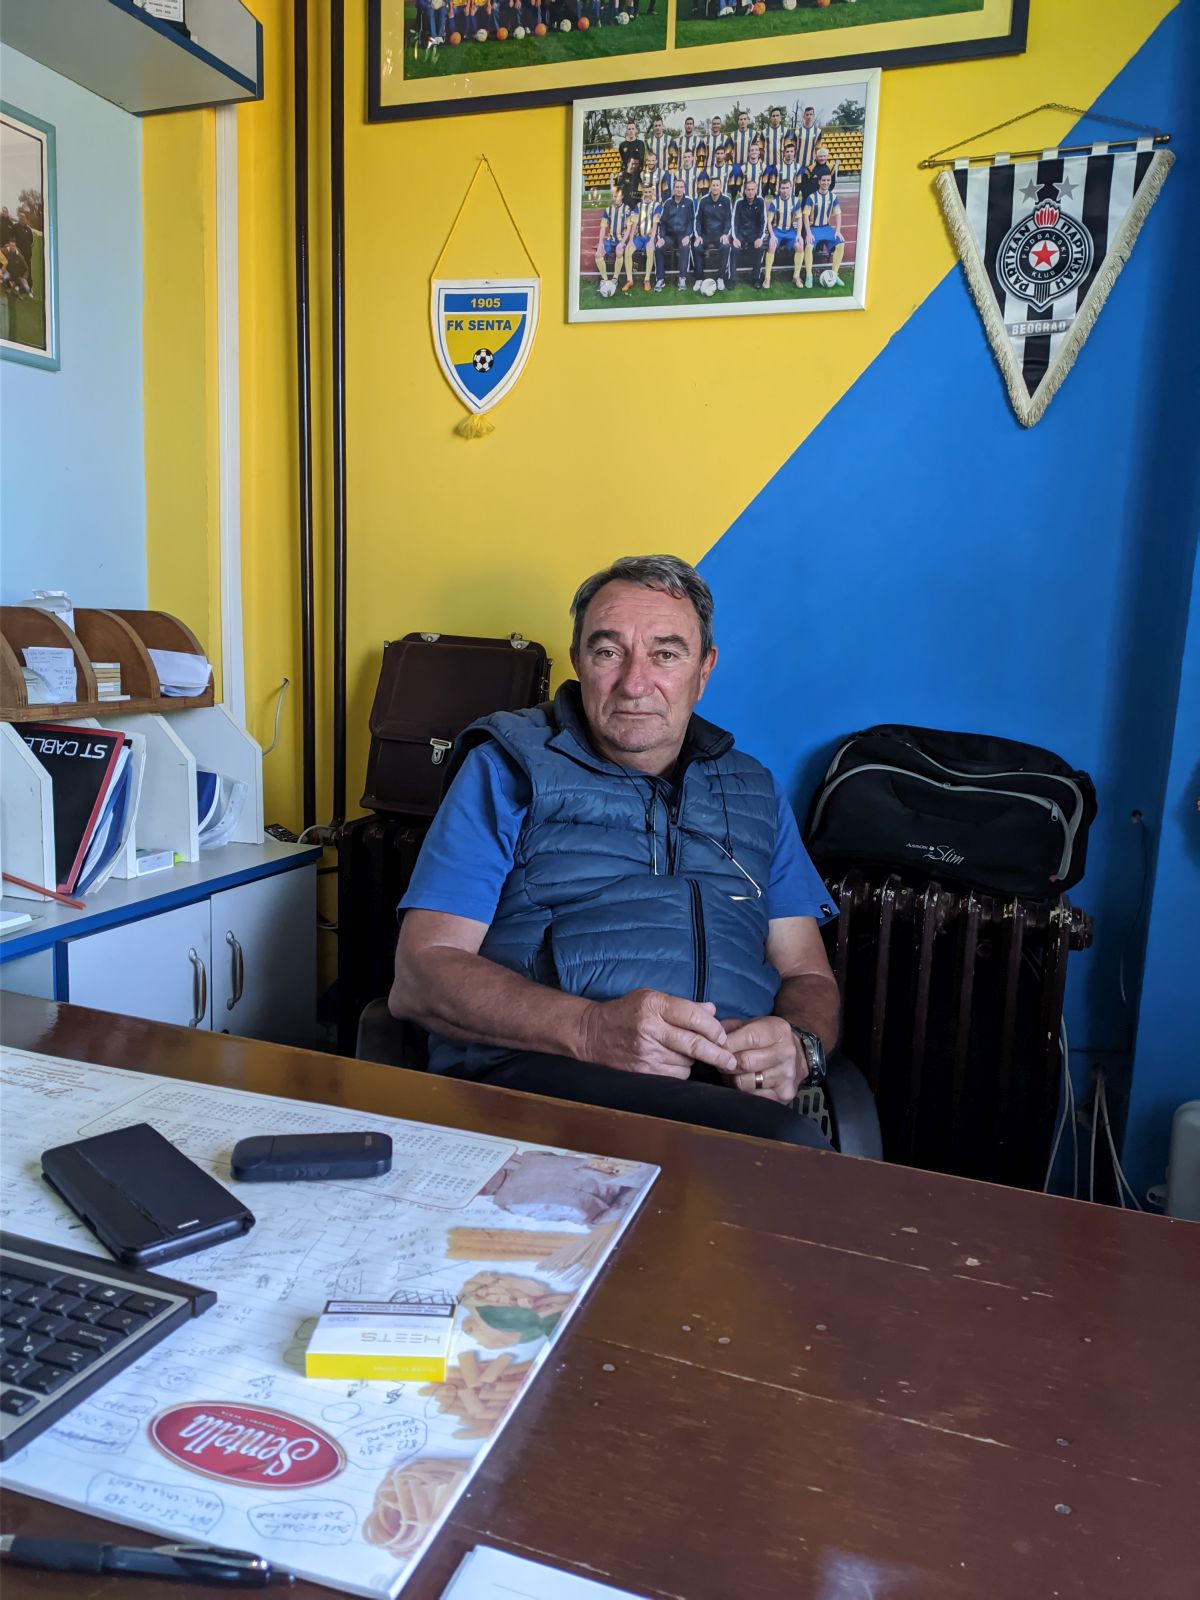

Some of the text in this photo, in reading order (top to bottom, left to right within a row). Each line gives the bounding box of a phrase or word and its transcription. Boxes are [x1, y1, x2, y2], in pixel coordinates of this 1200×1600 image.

[1021, 232, 1067, 259] FUDBALSKI
[1004, 223, 1031, 293] PARTIZAN
[1055, 221, 1084, 291] ПАРТИЗАН
[1031, 270, 1056, 279] KLUB
[470, 298, 501, 309] 1905
[446, 319, 512, 331] FK SENTA
[1011, 320, 1067, 335] BEOGRAD
[79, 742, 109, 760] ST
[926, 845, 965, 865] Slim
[360, 1332, 441, 1344] HEETS
[178, 1414, 320, 1477] Sentella
